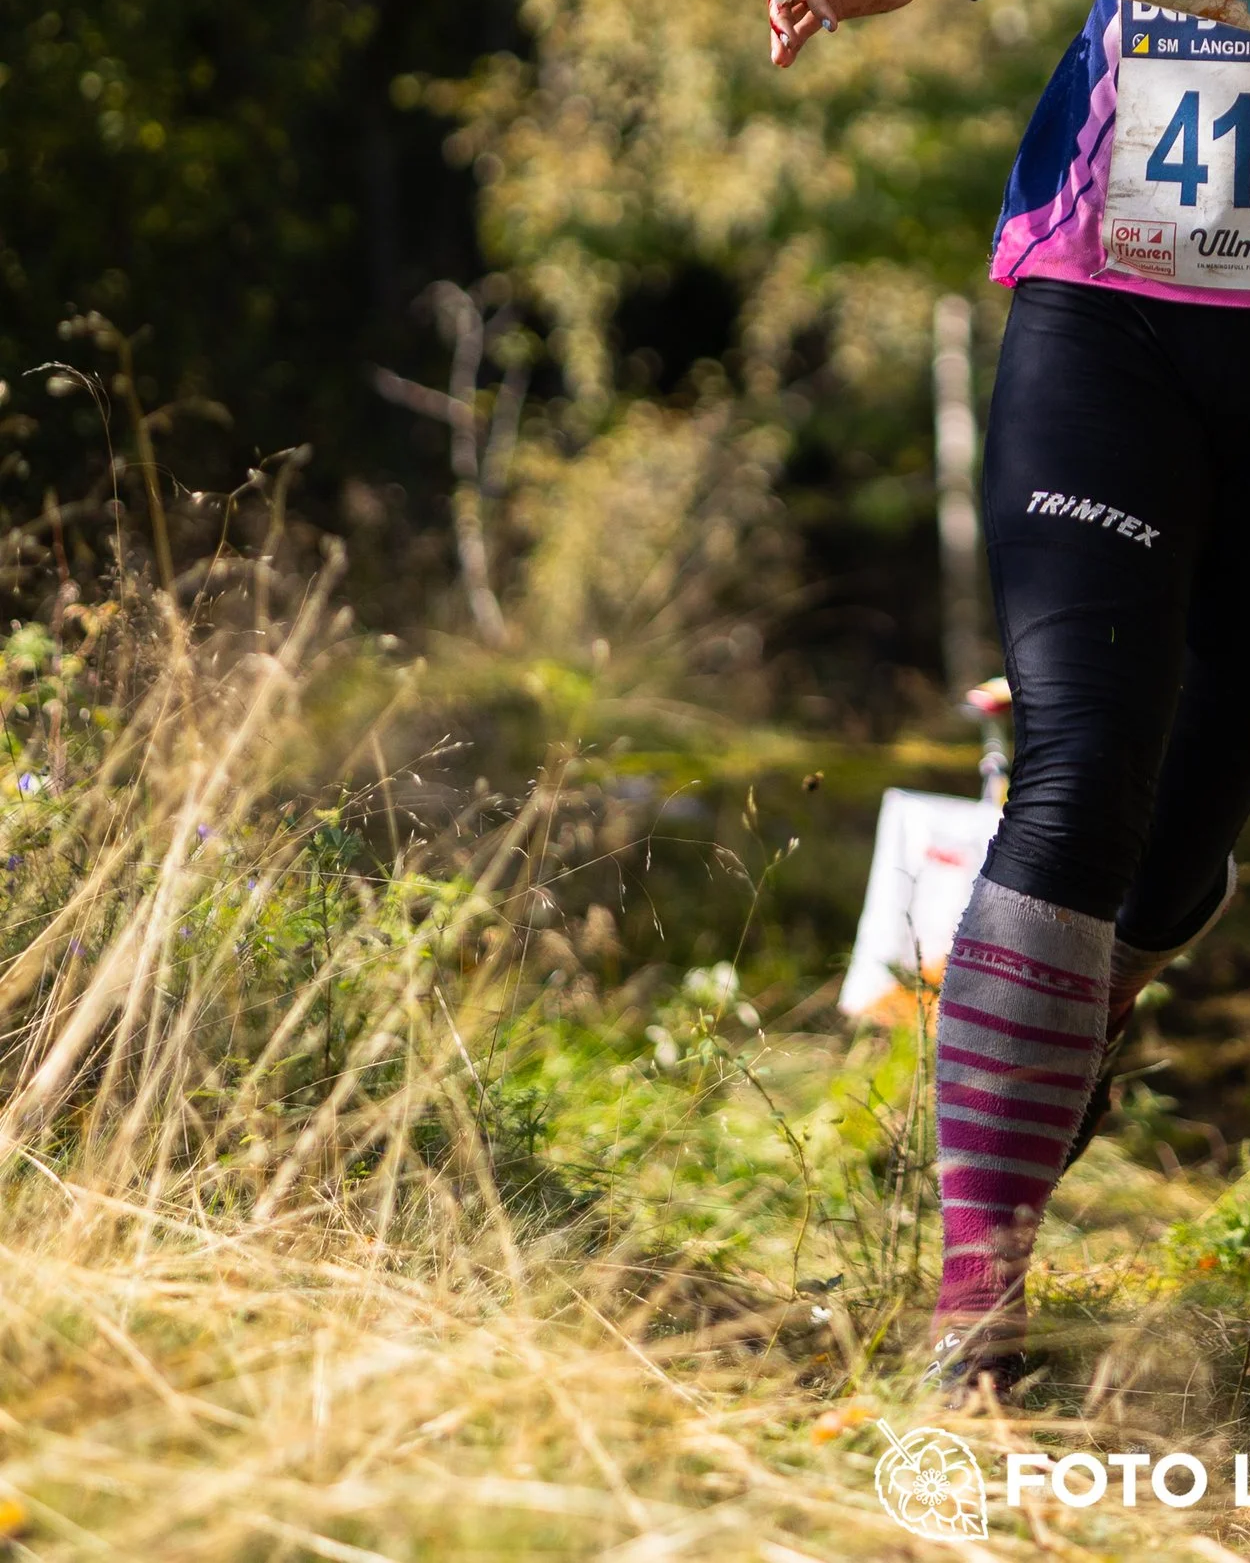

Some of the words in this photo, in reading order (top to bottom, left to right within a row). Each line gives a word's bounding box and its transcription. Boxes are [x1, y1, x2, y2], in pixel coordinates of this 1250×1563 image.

[1157, 38, 1179, 53] SM
[1115, 242, 1172, 261] Tisaren
[1026, 491, 1161, 549] TRIMTEX
